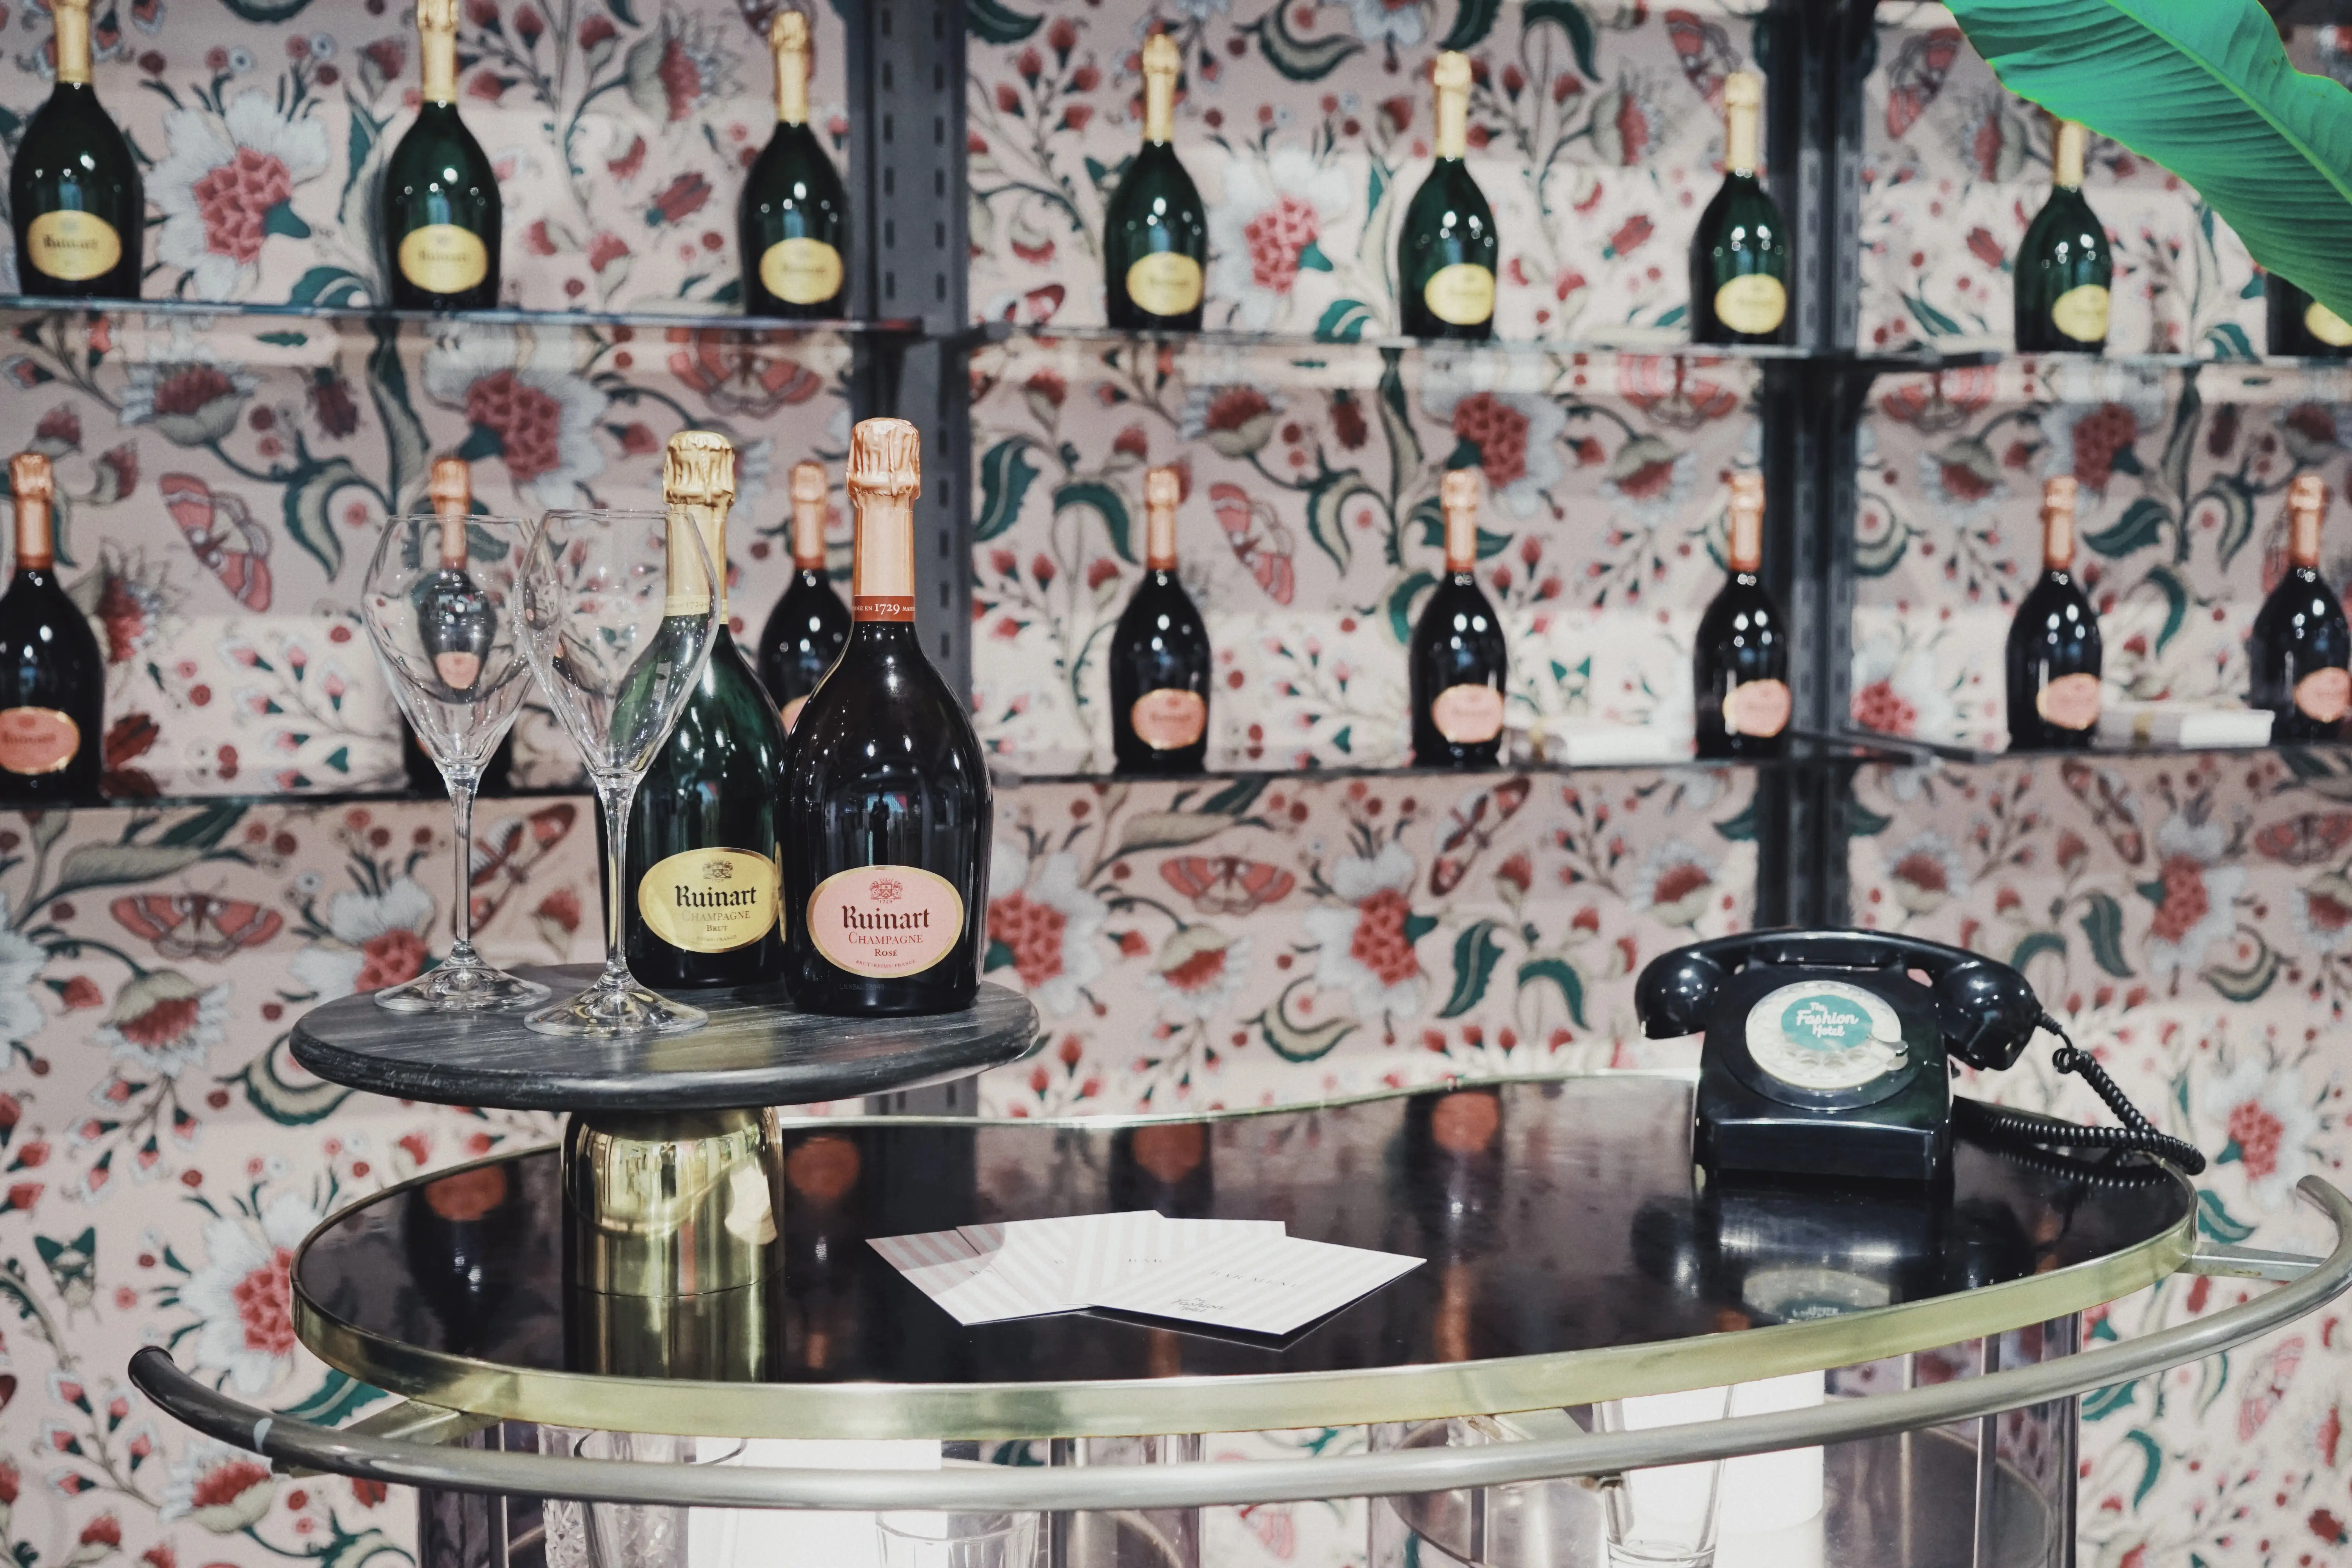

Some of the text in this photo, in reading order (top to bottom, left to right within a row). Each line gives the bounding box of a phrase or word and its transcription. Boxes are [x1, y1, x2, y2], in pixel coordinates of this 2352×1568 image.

[875, 604, 900, 615] 1729
[674, 885, 757, 907] Ruinart
[682, 910, 751, 922] CHAMPAGNE
[841, 905, 931, 930] Ruinart
[849, 931, 924, 945] CHAMPAGNE
[874, 948, 898, 956] ROSÉ
[1809, 1002, 1828, 1011] The
[1796, 1009, 1859, 1026] Fashion
[1812, 1024, 1846, 1038] Hotel
[1171, 1299, 1227, 1310] Fashion
